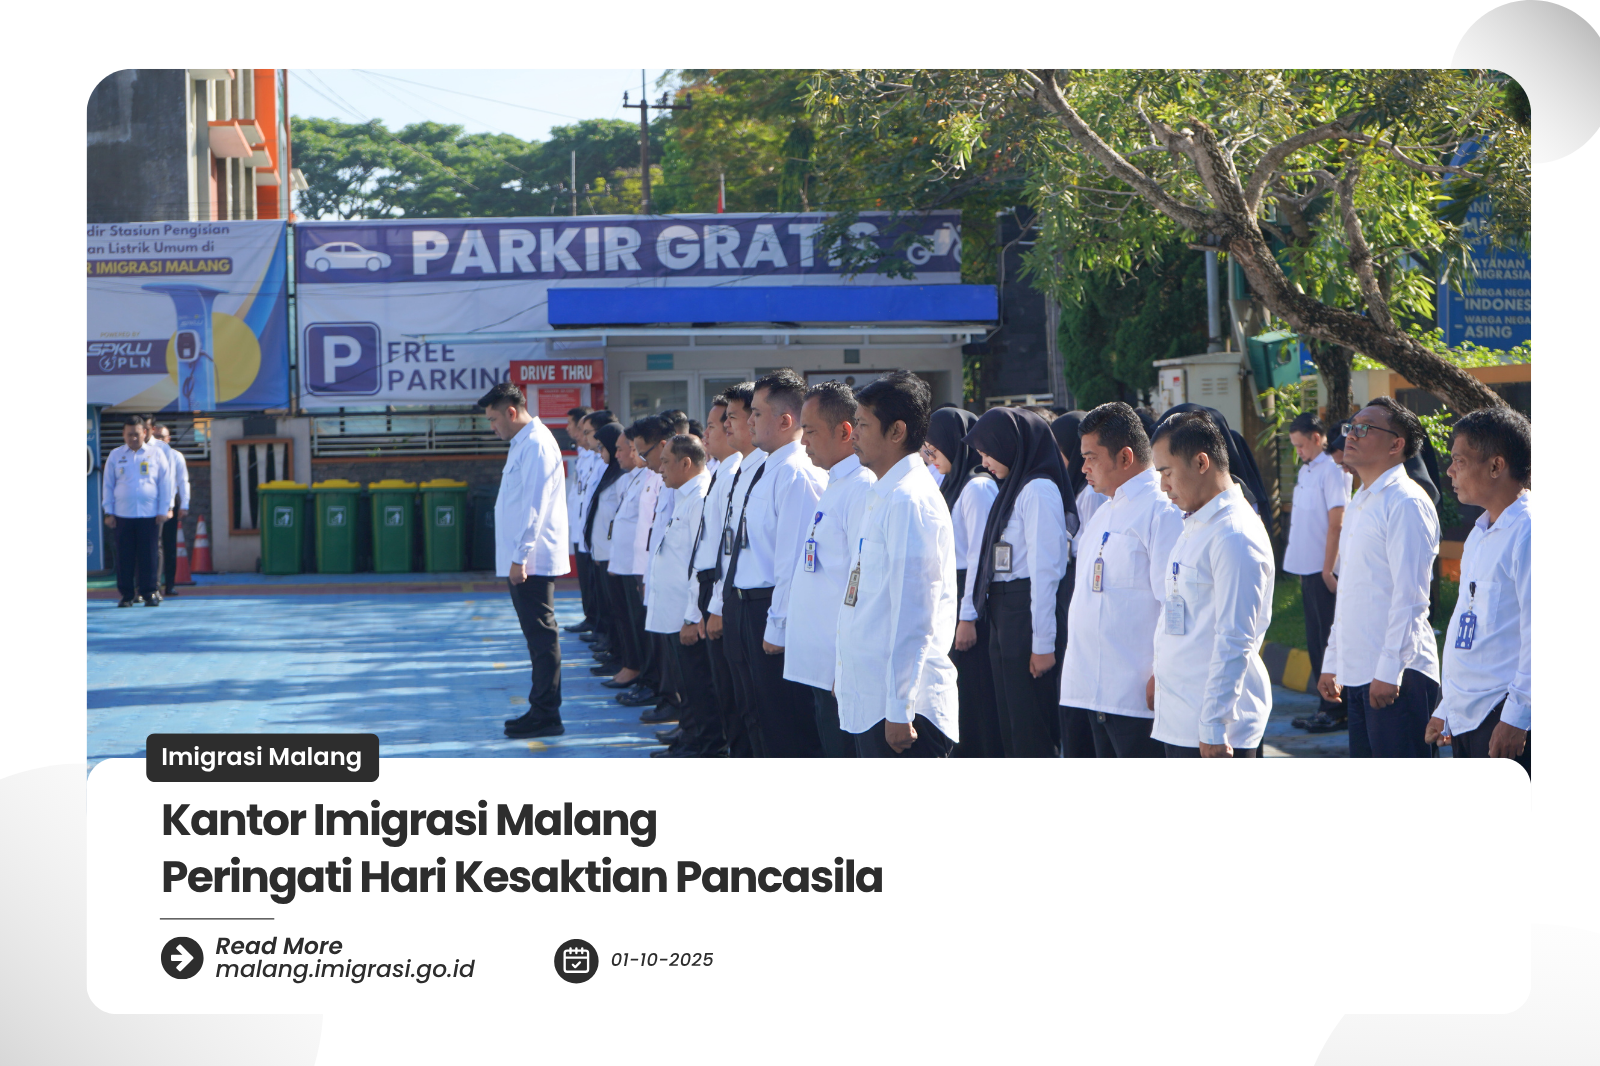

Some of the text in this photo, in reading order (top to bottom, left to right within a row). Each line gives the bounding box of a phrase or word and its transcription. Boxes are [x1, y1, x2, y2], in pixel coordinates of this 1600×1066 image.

[87, 224, 230, 238] dir Stasiun Pengisian
[87, 240, 215, 254] an Listrik Umum di
[412, 226, 642, 275] PARKIR
[96, 260, 163, 274] IMIGRASI
[165, 259, 231, 273] MALANG
[1465, 288, 1502, 298] WARGA
[1465, 315, 1502, 325] WARGA
[1464, 325, 1513, 339] ASING
[323, 335, 362, 384] P
[388, 342, 456, 363] FREE
[118, 356, 151, 369] PLN
[520, 365, 593, 380] DRIVE THRU
